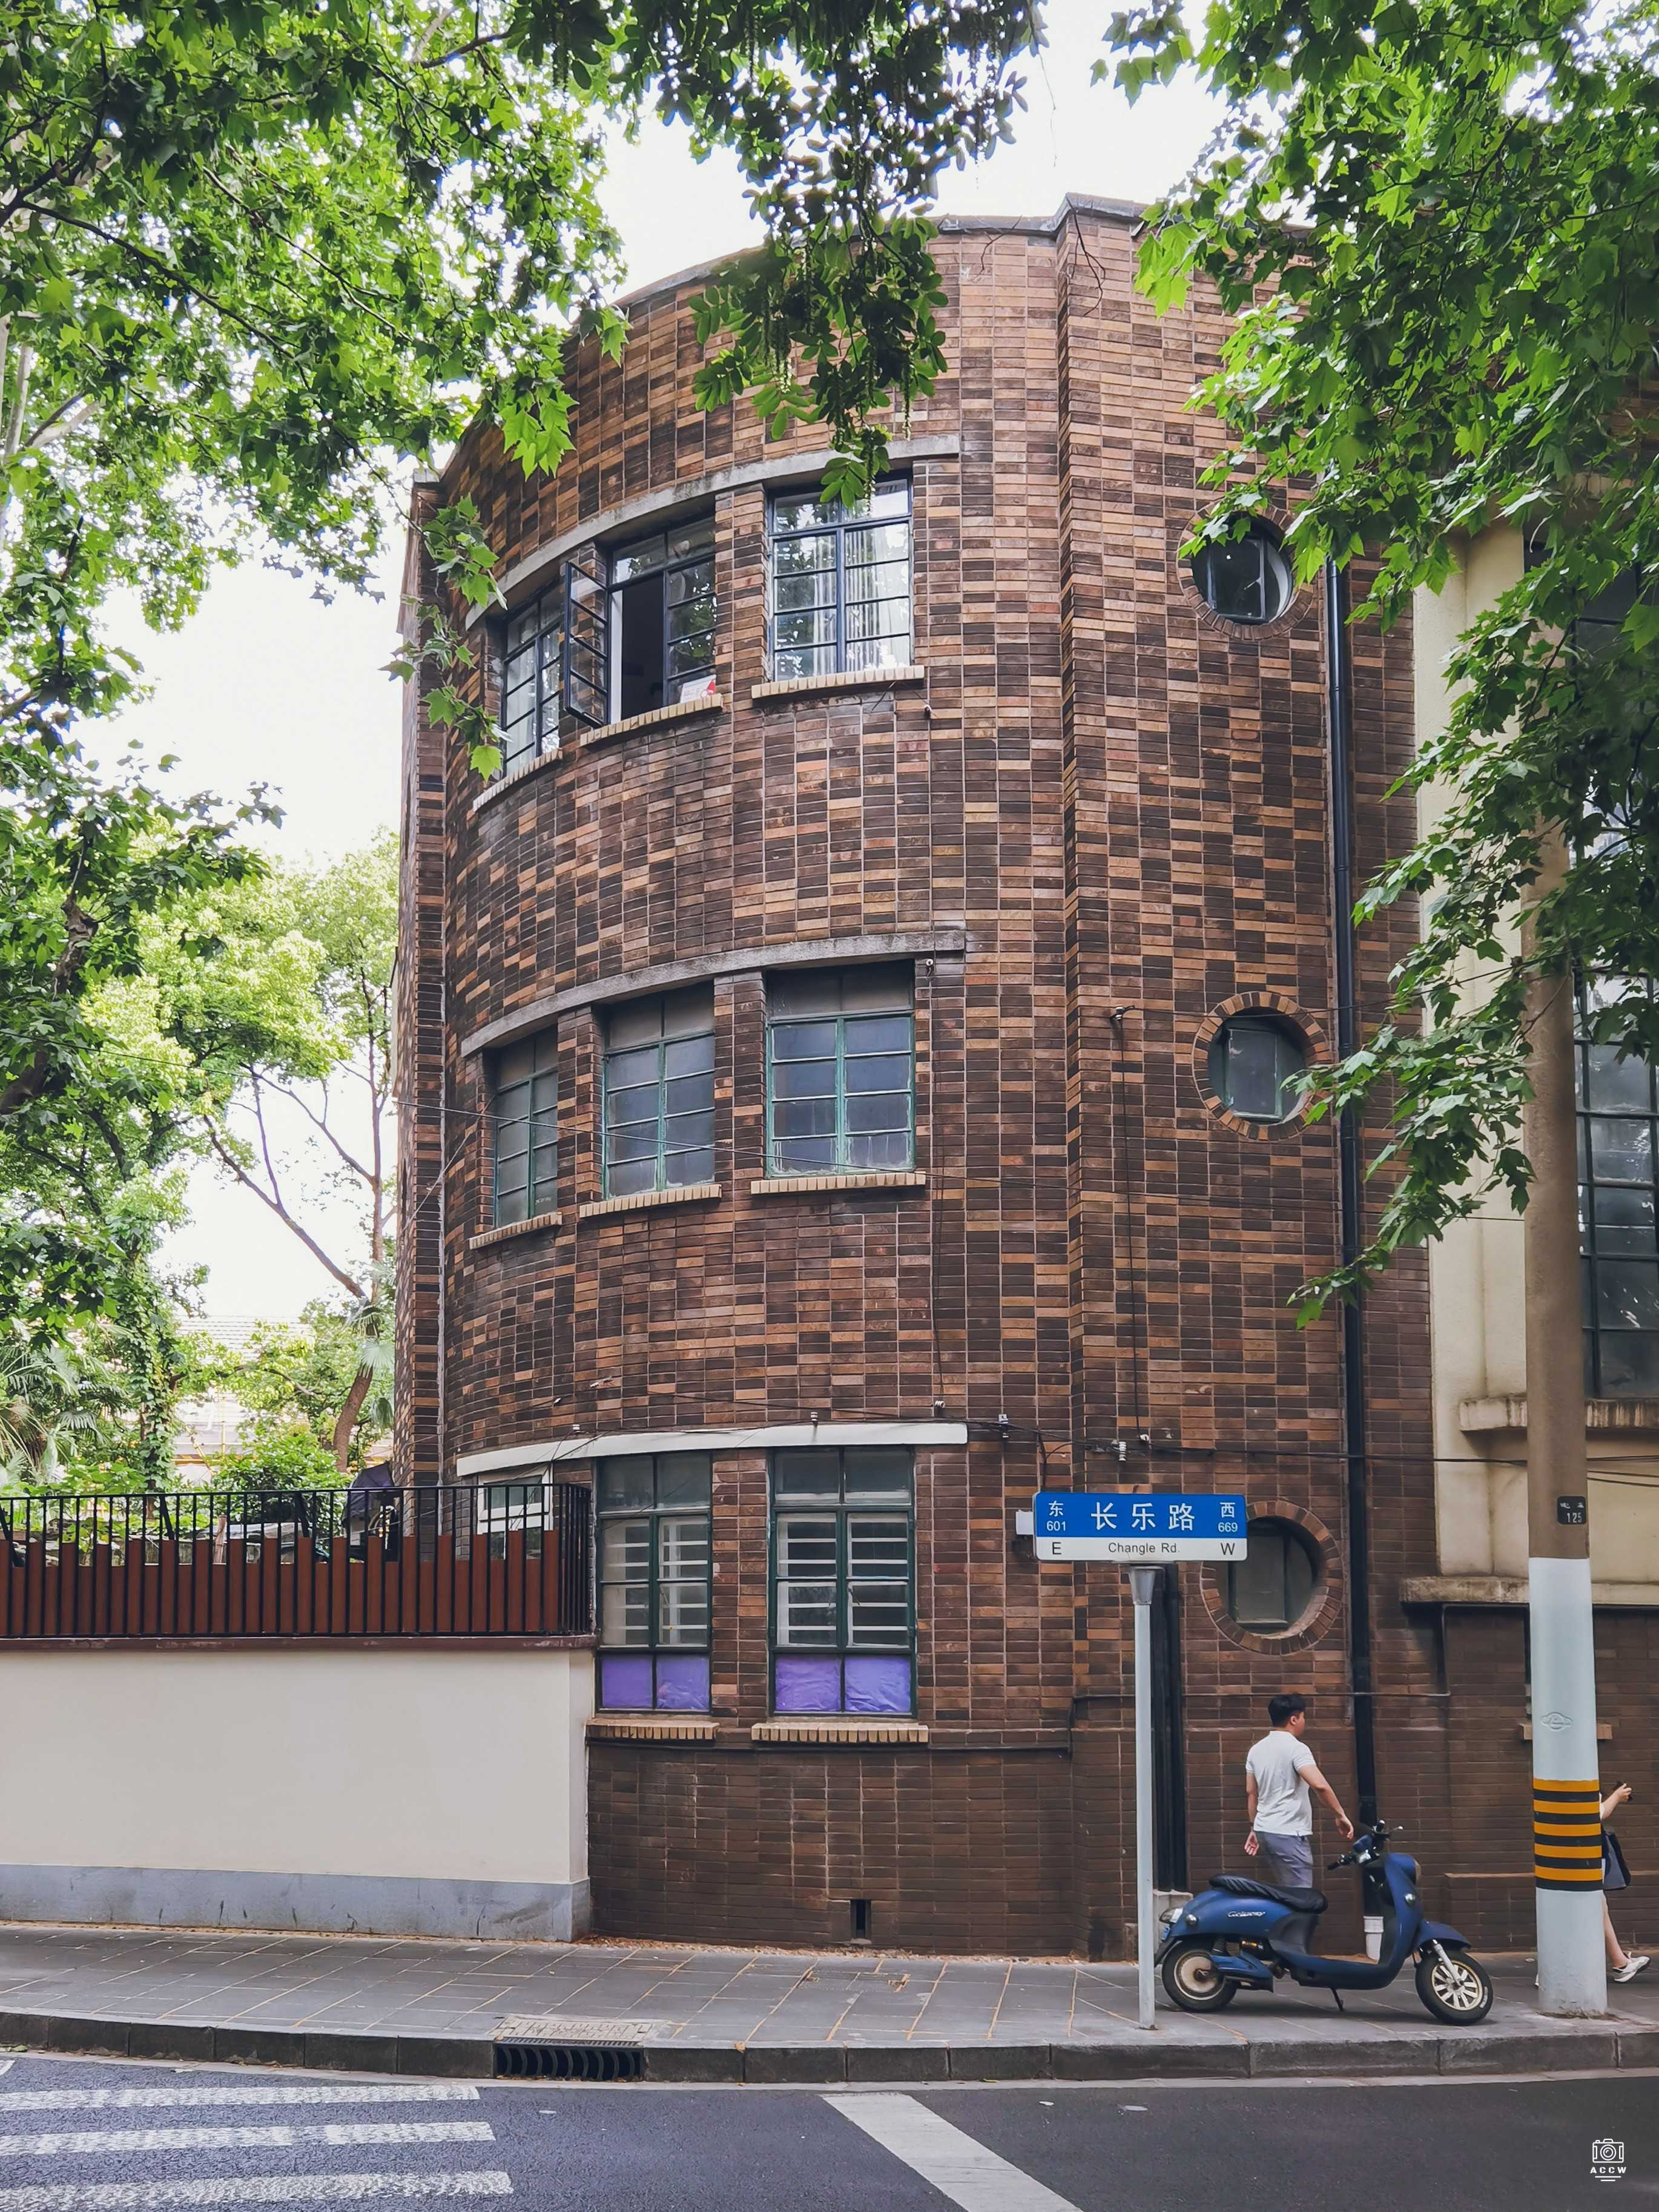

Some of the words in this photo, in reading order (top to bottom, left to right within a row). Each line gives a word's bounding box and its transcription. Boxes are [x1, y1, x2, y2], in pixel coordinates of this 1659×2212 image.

[1048, 1500, 1064, 1517] 东
[1219, 1502, 1236, 1518] 西
[1090, 1501, 1195, 1531] 长乐路
[1566, 1512, 1582, 1523] 125
[1046, 1520, 1066, 1532] 601
[1218, 1522, 1238, 1533] 669
[1052, 1542, 1062, 1555] E
[1108, 1542, 1156, 1555] Changle
[1161, 1542, 1181, 1553] Rd.
[1220, 1542, 1236, 1555] W
